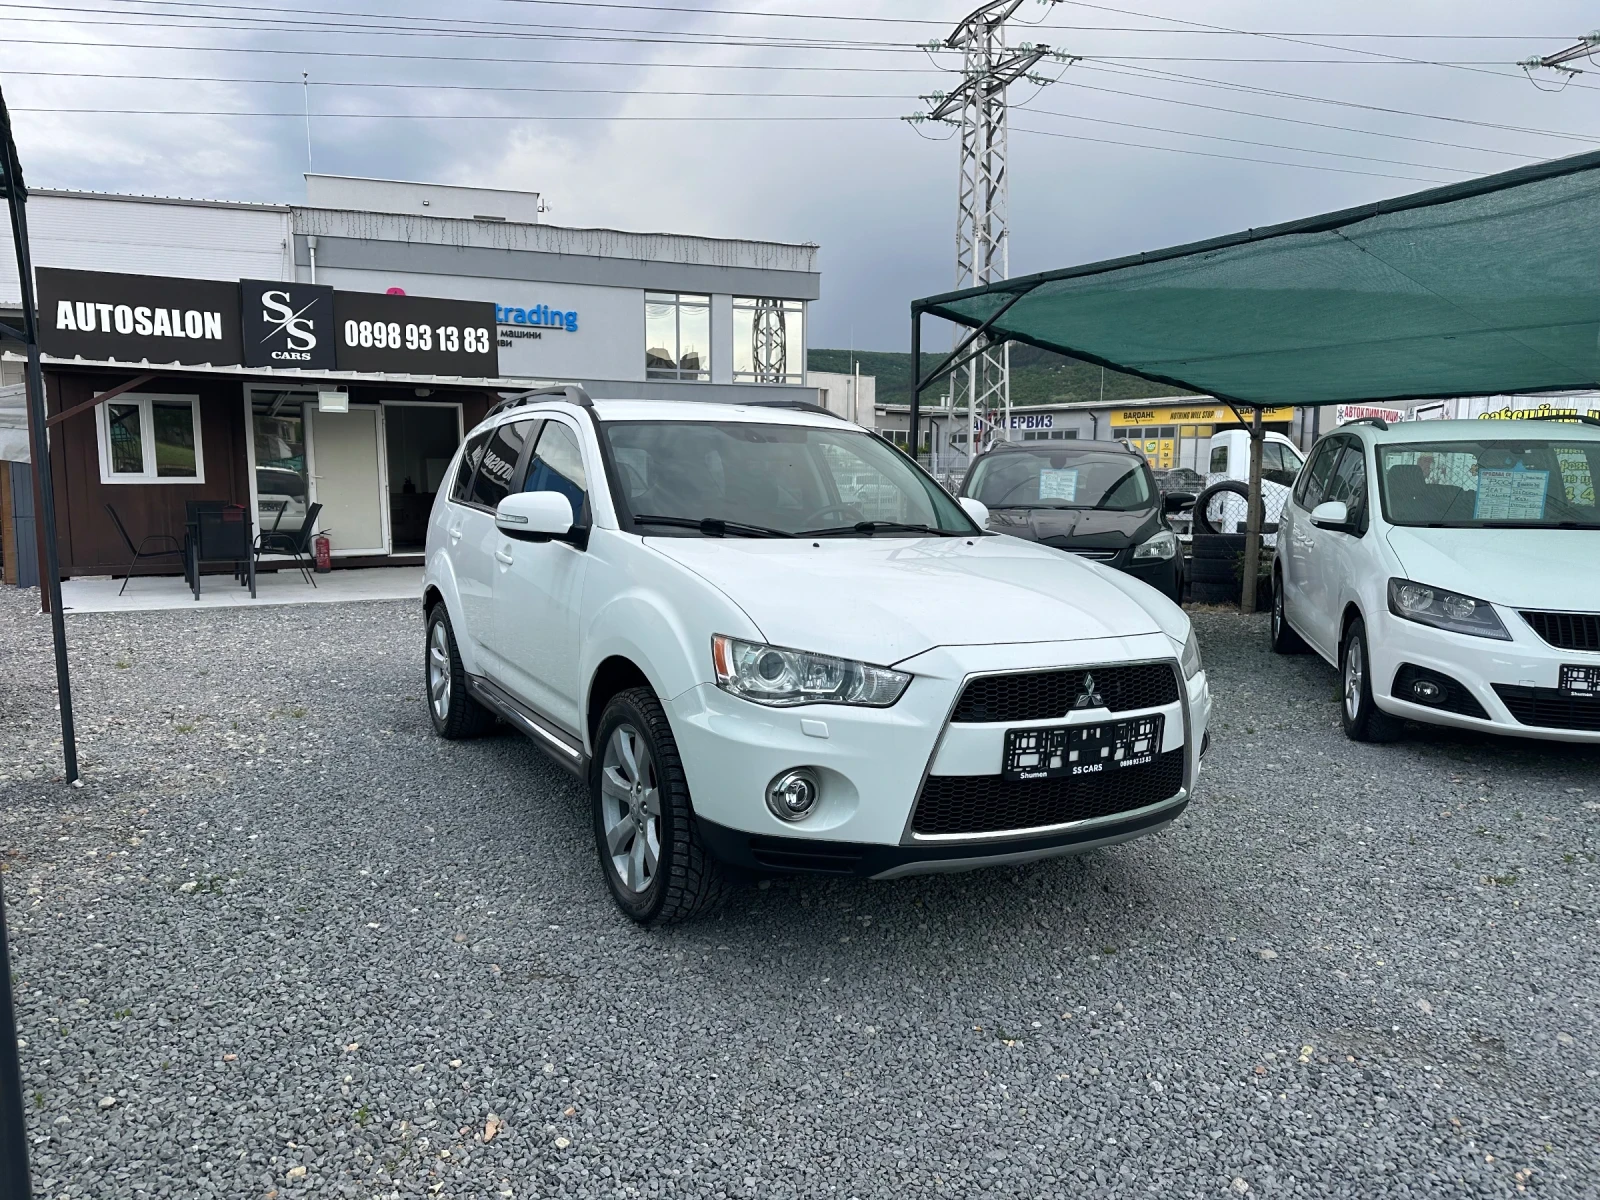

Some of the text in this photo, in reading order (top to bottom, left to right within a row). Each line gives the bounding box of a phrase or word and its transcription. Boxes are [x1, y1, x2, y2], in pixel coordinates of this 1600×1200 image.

[56, 300, 222, 340] AUTOSALON
[496, 303, 578, 332] trading
[344, 319, 490, 354] 0898 93 13 83
[500, 329, 542, 340] машини
[271, 351, 311, 361] CARS
[1123, 410, 1155, 423] BARDAHL
[1169, 411, 1190, 420] NOTHING
[1190, 410, 1201, 419] WILL
[1201, 410, 1215, 419] STOP
[1119, 759, 1133, 768] 0898
[1139, 756, 1145, 764] 13
[1145, 755, 1152, 763] 83
[1020, 771, 1048, 779] Shumen
[1072, 763, 1103, 775] SS CARS
